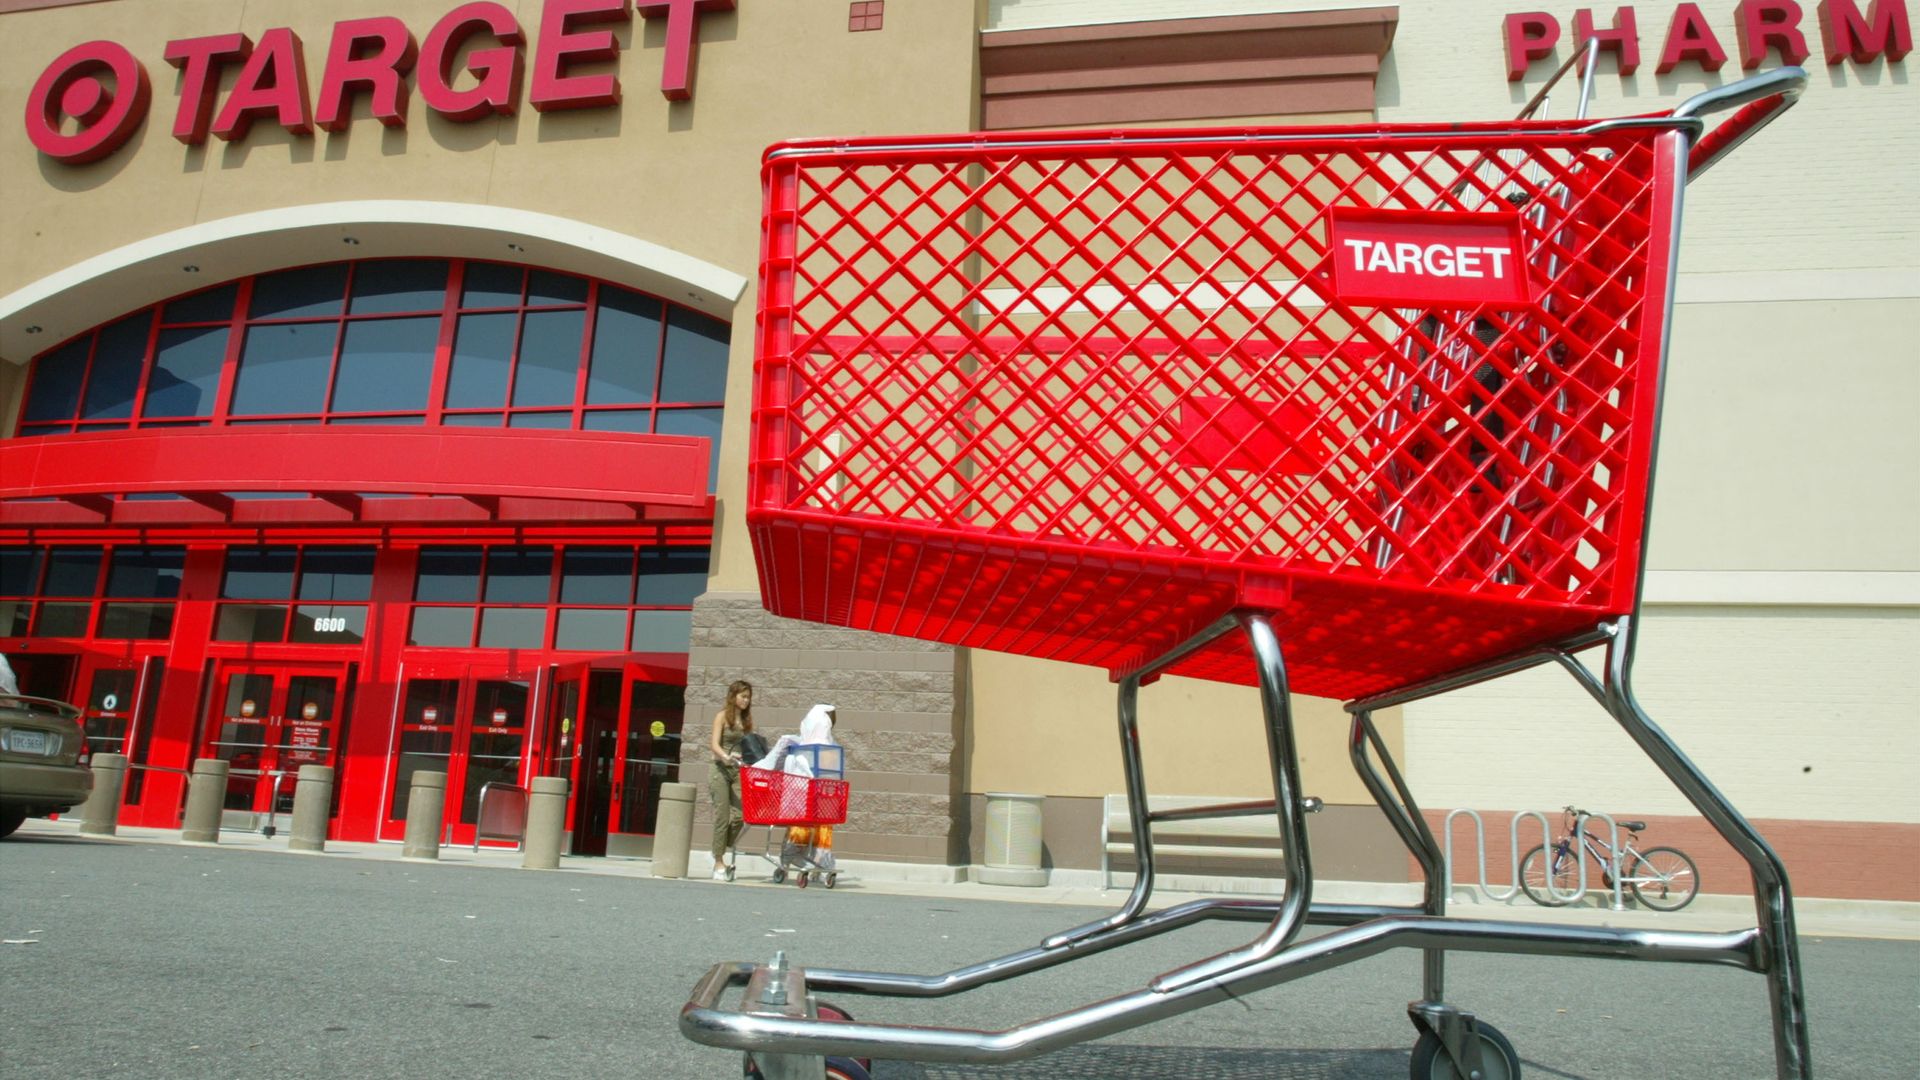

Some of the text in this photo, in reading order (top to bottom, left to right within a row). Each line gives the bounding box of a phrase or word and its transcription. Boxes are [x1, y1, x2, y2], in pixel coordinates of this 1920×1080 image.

[1501, 0, 1914, 82] PHARM
[163, 0, 737, 146] TARGET
[1344, 239, 1511, 279] TARGET
[314, 617, 346, 632] 6600
